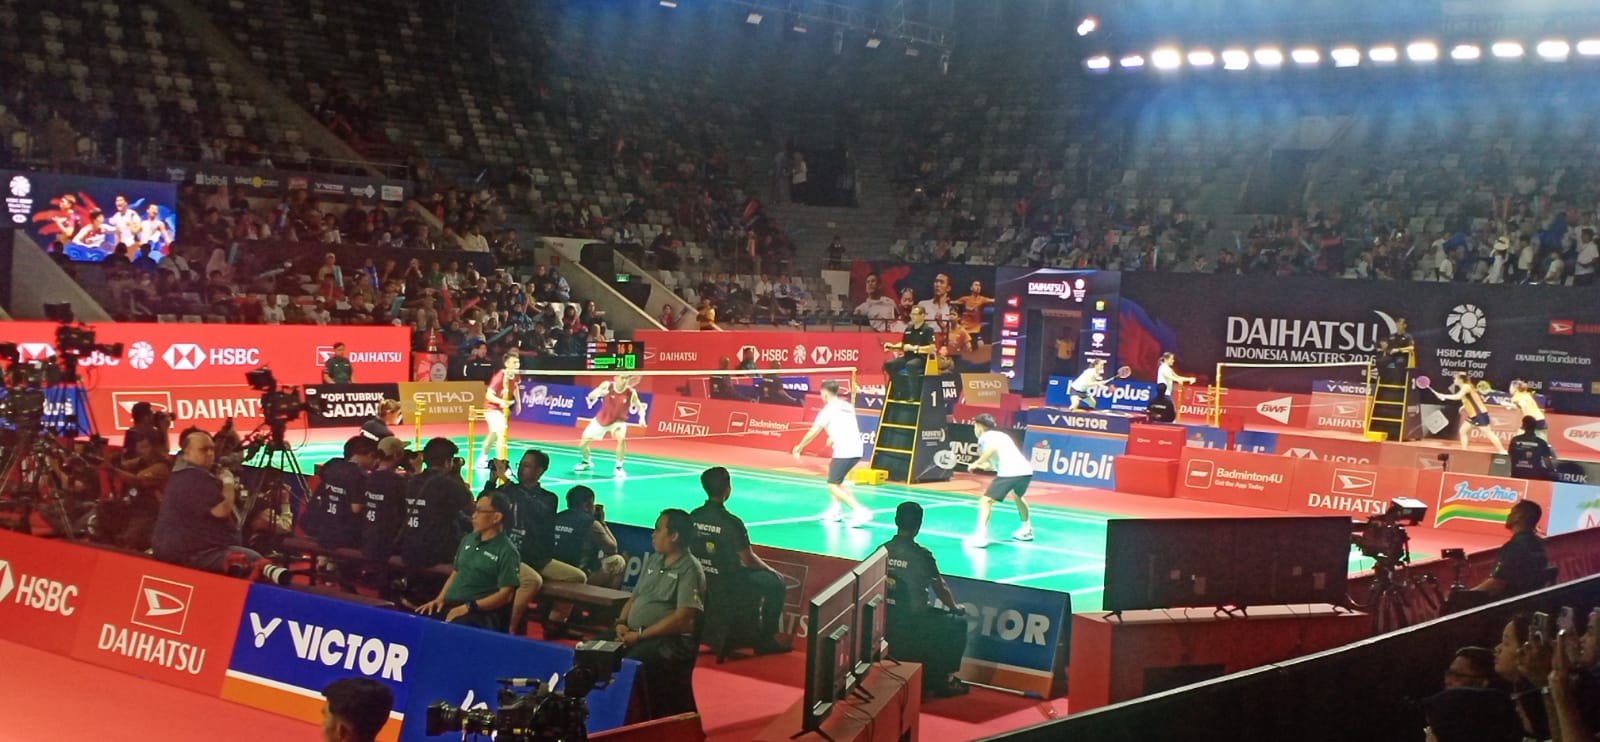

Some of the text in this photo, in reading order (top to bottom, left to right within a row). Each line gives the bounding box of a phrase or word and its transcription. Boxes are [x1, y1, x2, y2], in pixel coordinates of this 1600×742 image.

[1226, 316, 1378, 352] DAIHATSU
[209, 348, 260, 366] HSBC
[350, 352, 402, 363] DAIHATSU
[659, 351, 698, 361] DAIHATSU
[762, 349, 789, 361] HSBC
[834, 349, 859, 361] HSBC
[1226, 347, 1288, 362] INDONESIA
[1291, 351, 1346, 364] MASTERS
[1436, 349, 1492, 359] HSBC BWF
[1547, 354, 1592, 366] foundation
[1440, 359, 1488, 369] World Tour
[969, 380, 1002, 390] ETIHAD
[347, 393, 385, 402] TUBRUK
[413, 392, 475, 403] ETIHAD
[930, 390, 937, 407] 1
[176, 398, 265, 419] DAIHAT
[429, 406, 463, 415] AIRWAYS
[1260, 404, 1289, 413] BWF
[657, 421, 709, 436] DAIHATSU
[1062, 415, 1108, 430] VICTOR
[1052, 449, 1114, 480] blibli
[1216, 467, 1284, 484] Badminton4U
[366, 510, 376, 522] 45
[408, 516, 419, 528] 46
[15, 574, 79, 616] HSBC
[98, 623, 207, 675] DAIHATSU
[287, 620, 410, 683] VICTOR
